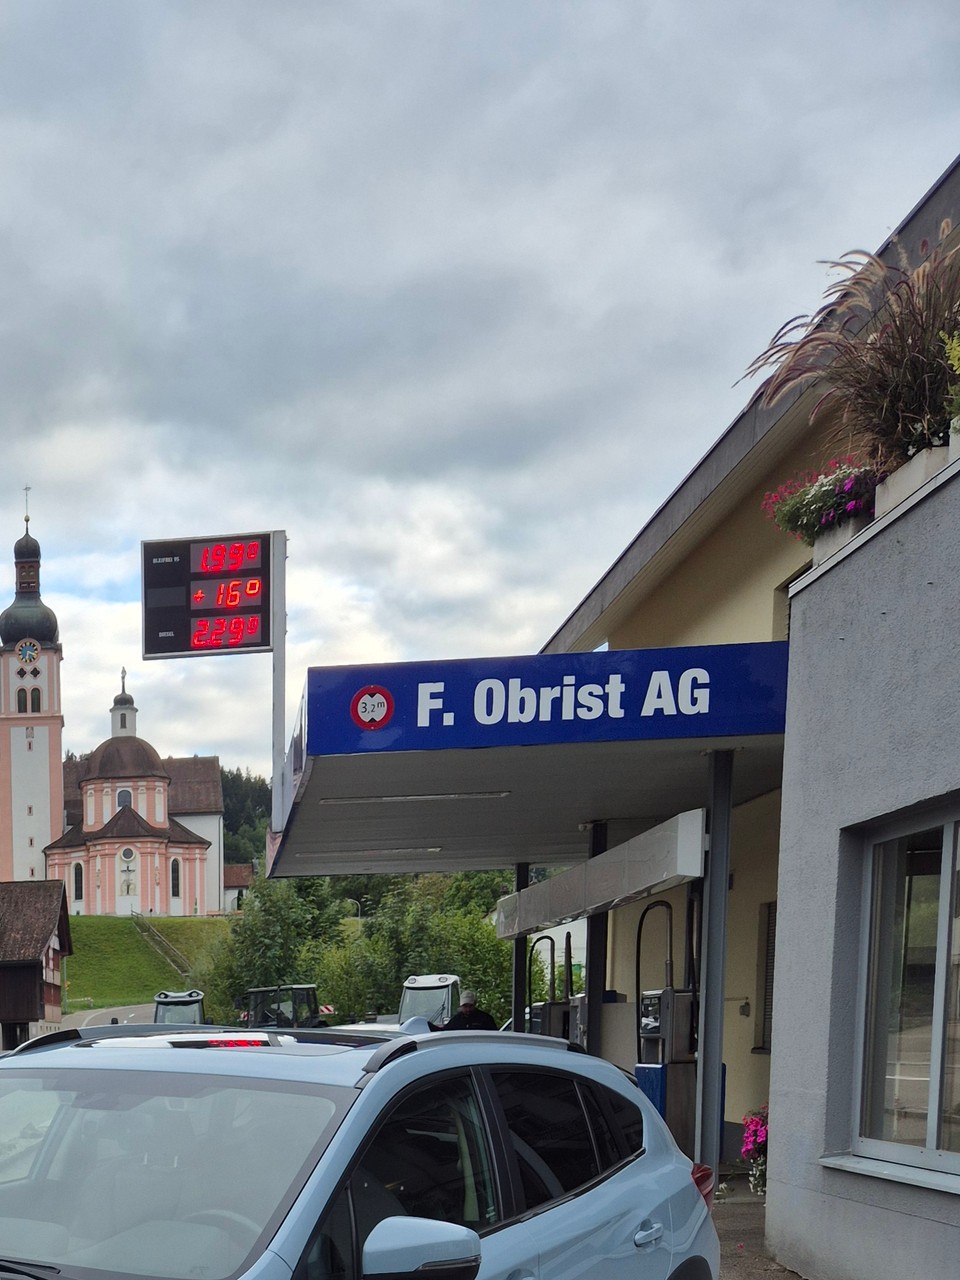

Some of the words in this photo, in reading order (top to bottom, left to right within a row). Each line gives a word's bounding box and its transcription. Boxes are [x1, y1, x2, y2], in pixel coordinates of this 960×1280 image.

[416, 682, 455, 728] F.
[473, 674, 626, 726] Obrist
[640, 667, 711, 717] AG
